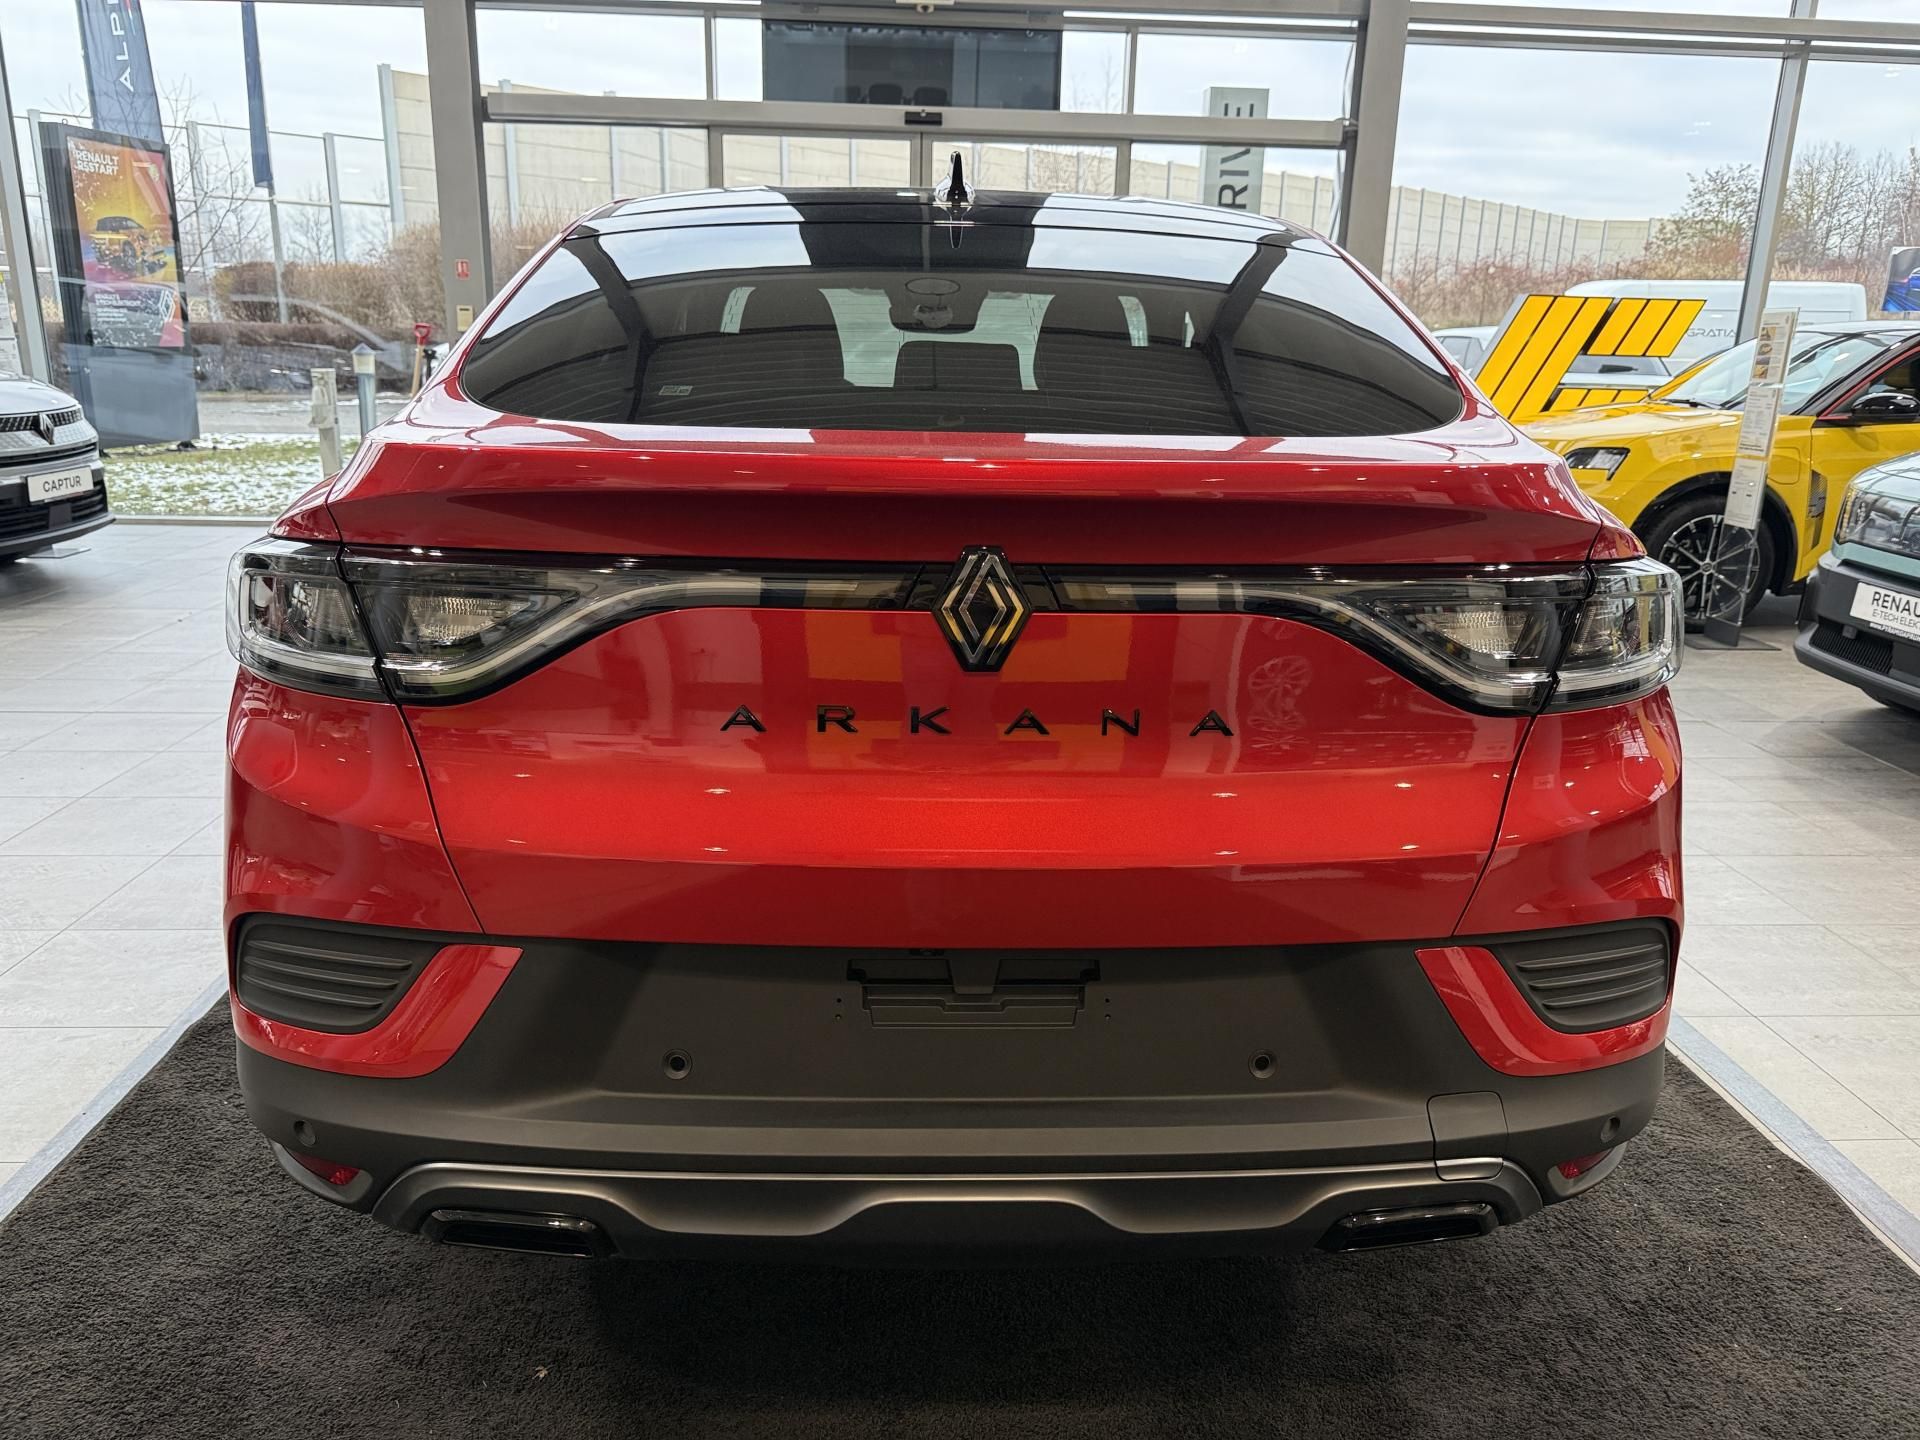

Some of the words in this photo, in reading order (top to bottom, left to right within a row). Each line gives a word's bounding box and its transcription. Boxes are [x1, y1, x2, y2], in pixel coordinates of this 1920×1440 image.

[76, 150, 119, 165] RENAULT
[42, 475, 82, 493] CAPTUR
[1872, 608, 1898, 624] E-TECH
[719, 703, 1235, 738] ARKANA
